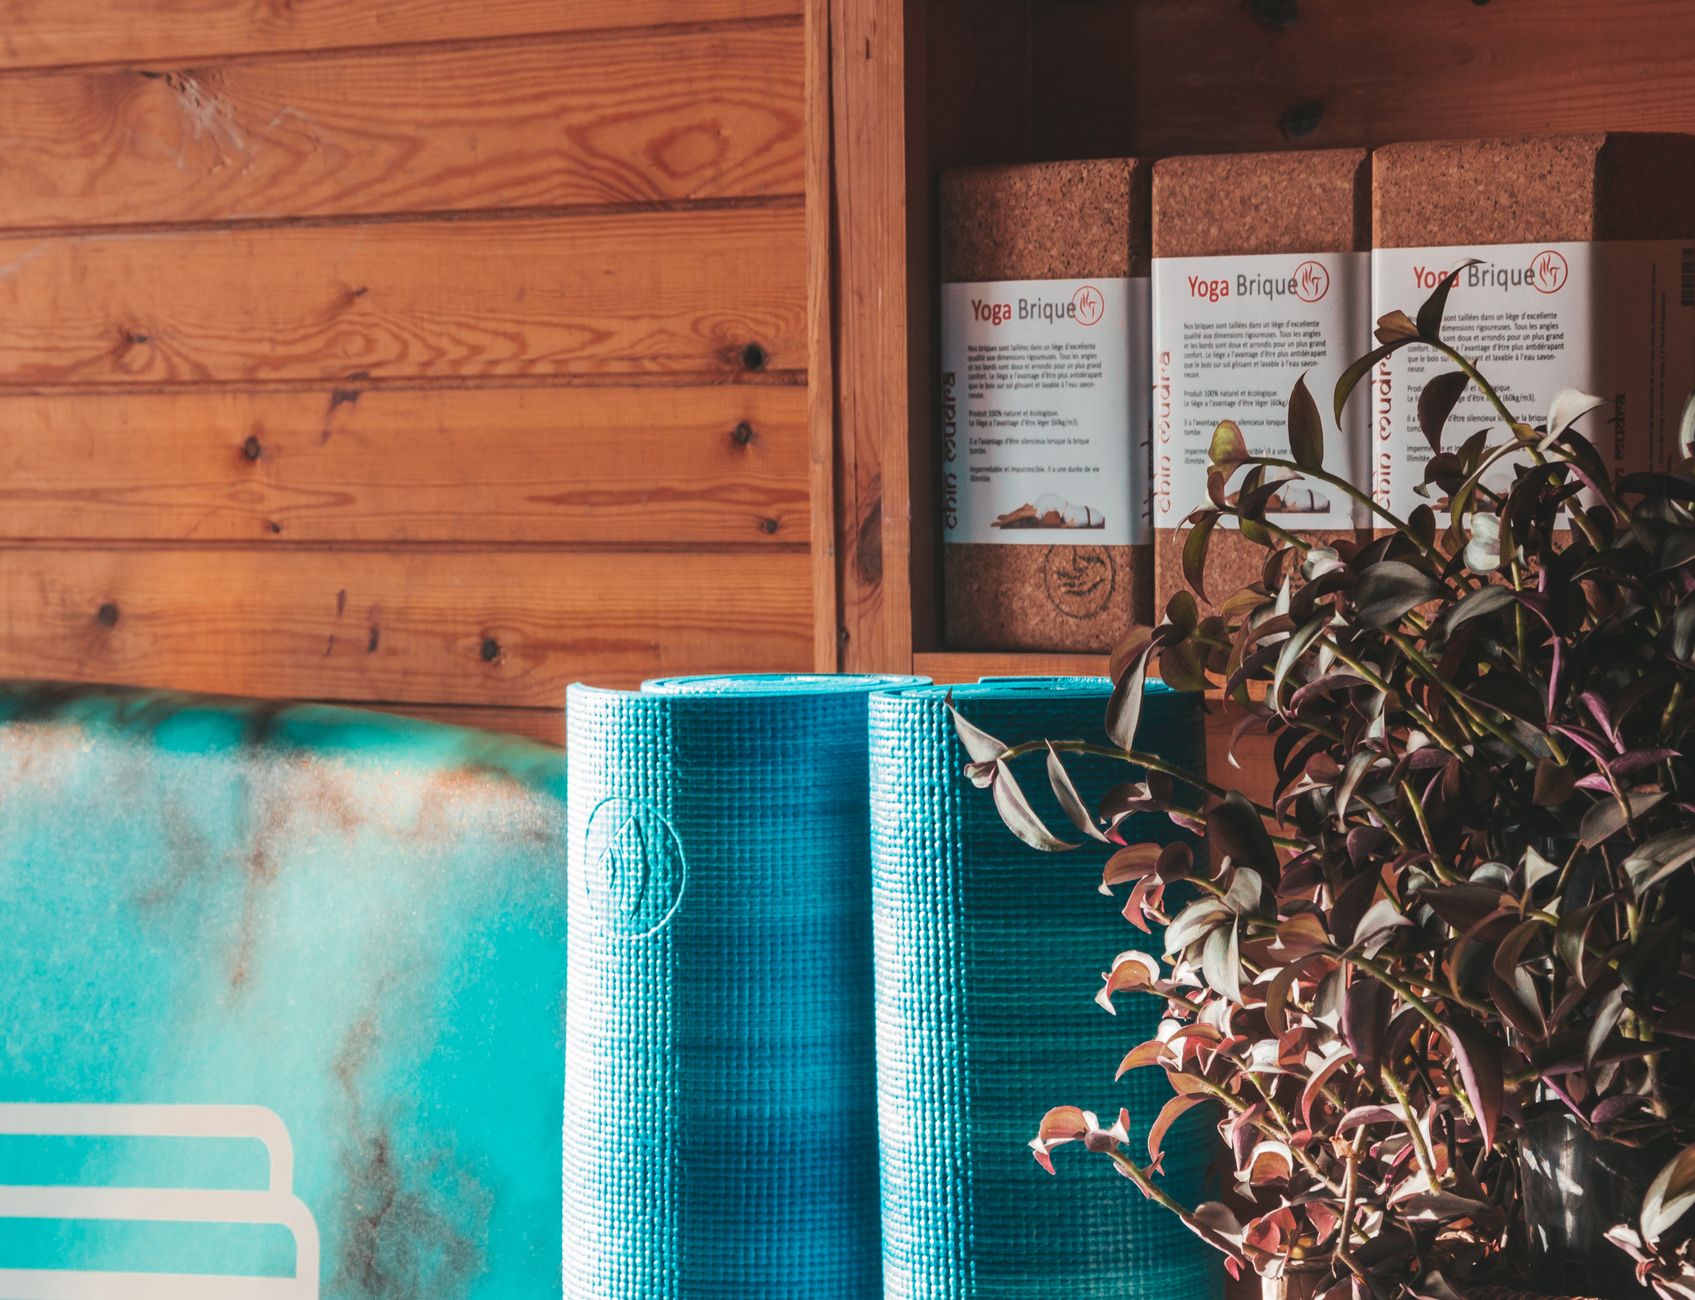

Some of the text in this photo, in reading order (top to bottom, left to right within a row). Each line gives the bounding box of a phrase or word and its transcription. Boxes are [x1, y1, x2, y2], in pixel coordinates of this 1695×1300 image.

[1468, 264, 1535, 291] Brique
[1188, 274, 1297, 302] Yoga Brique
[971, 298, 1076, 325] Yoga Brique
[1458, 313, 1479, 321] taillées
[1481, 313, 1495, 321] dans
[1506, 313, 1519, 322] liège
[1521, 312, 1557, 320] d'excellente
[1442, 324, 1475, 332] dimensions
[1477, 324, 1512, 333] rigoureuses.
[1539, 323, 1559, 332] angles
[1457, 334, 1472, 342] doux
[1532, 333, 1544, 342] plus
[1546, 333, 1564, 342] grand
[1461, 344, 1490, 353] l'avantage
[1492, 343, 1510, 351] d'être
[1511, 343, 1524, 352] plus
[1525, 343, 1564, 352] antidérapant
[1270, 399, 1288, 408] (60kg/
[1152, 351, 1171, 514] chin mudra
